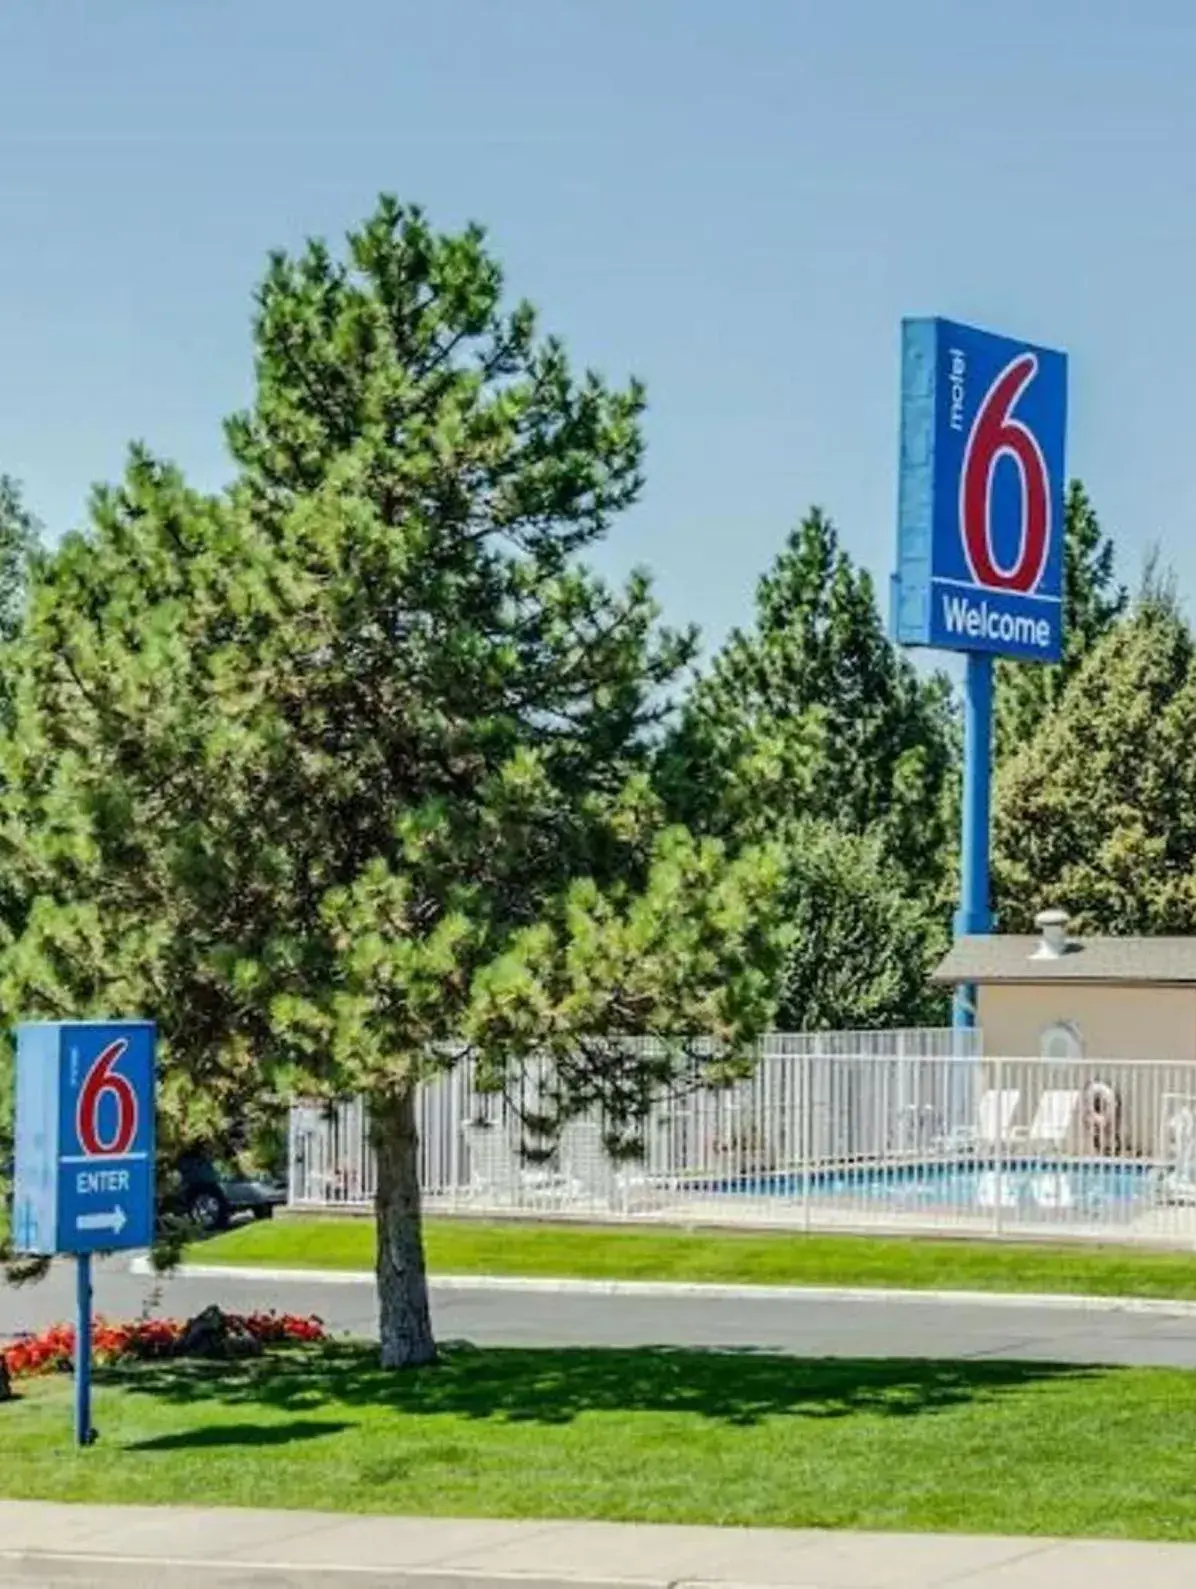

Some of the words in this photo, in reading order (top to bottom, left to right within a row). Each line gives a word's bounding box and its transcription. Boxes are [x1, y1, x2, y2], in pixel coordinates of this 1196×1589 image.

[949, 348, 967, 431] motel
[959, 352, 1052, 596] 6
[943, 595, 1051, 648] Welcome
[76, 1038, 138, 1158] 6
[76, 1170, 130, 1194] ENTER
